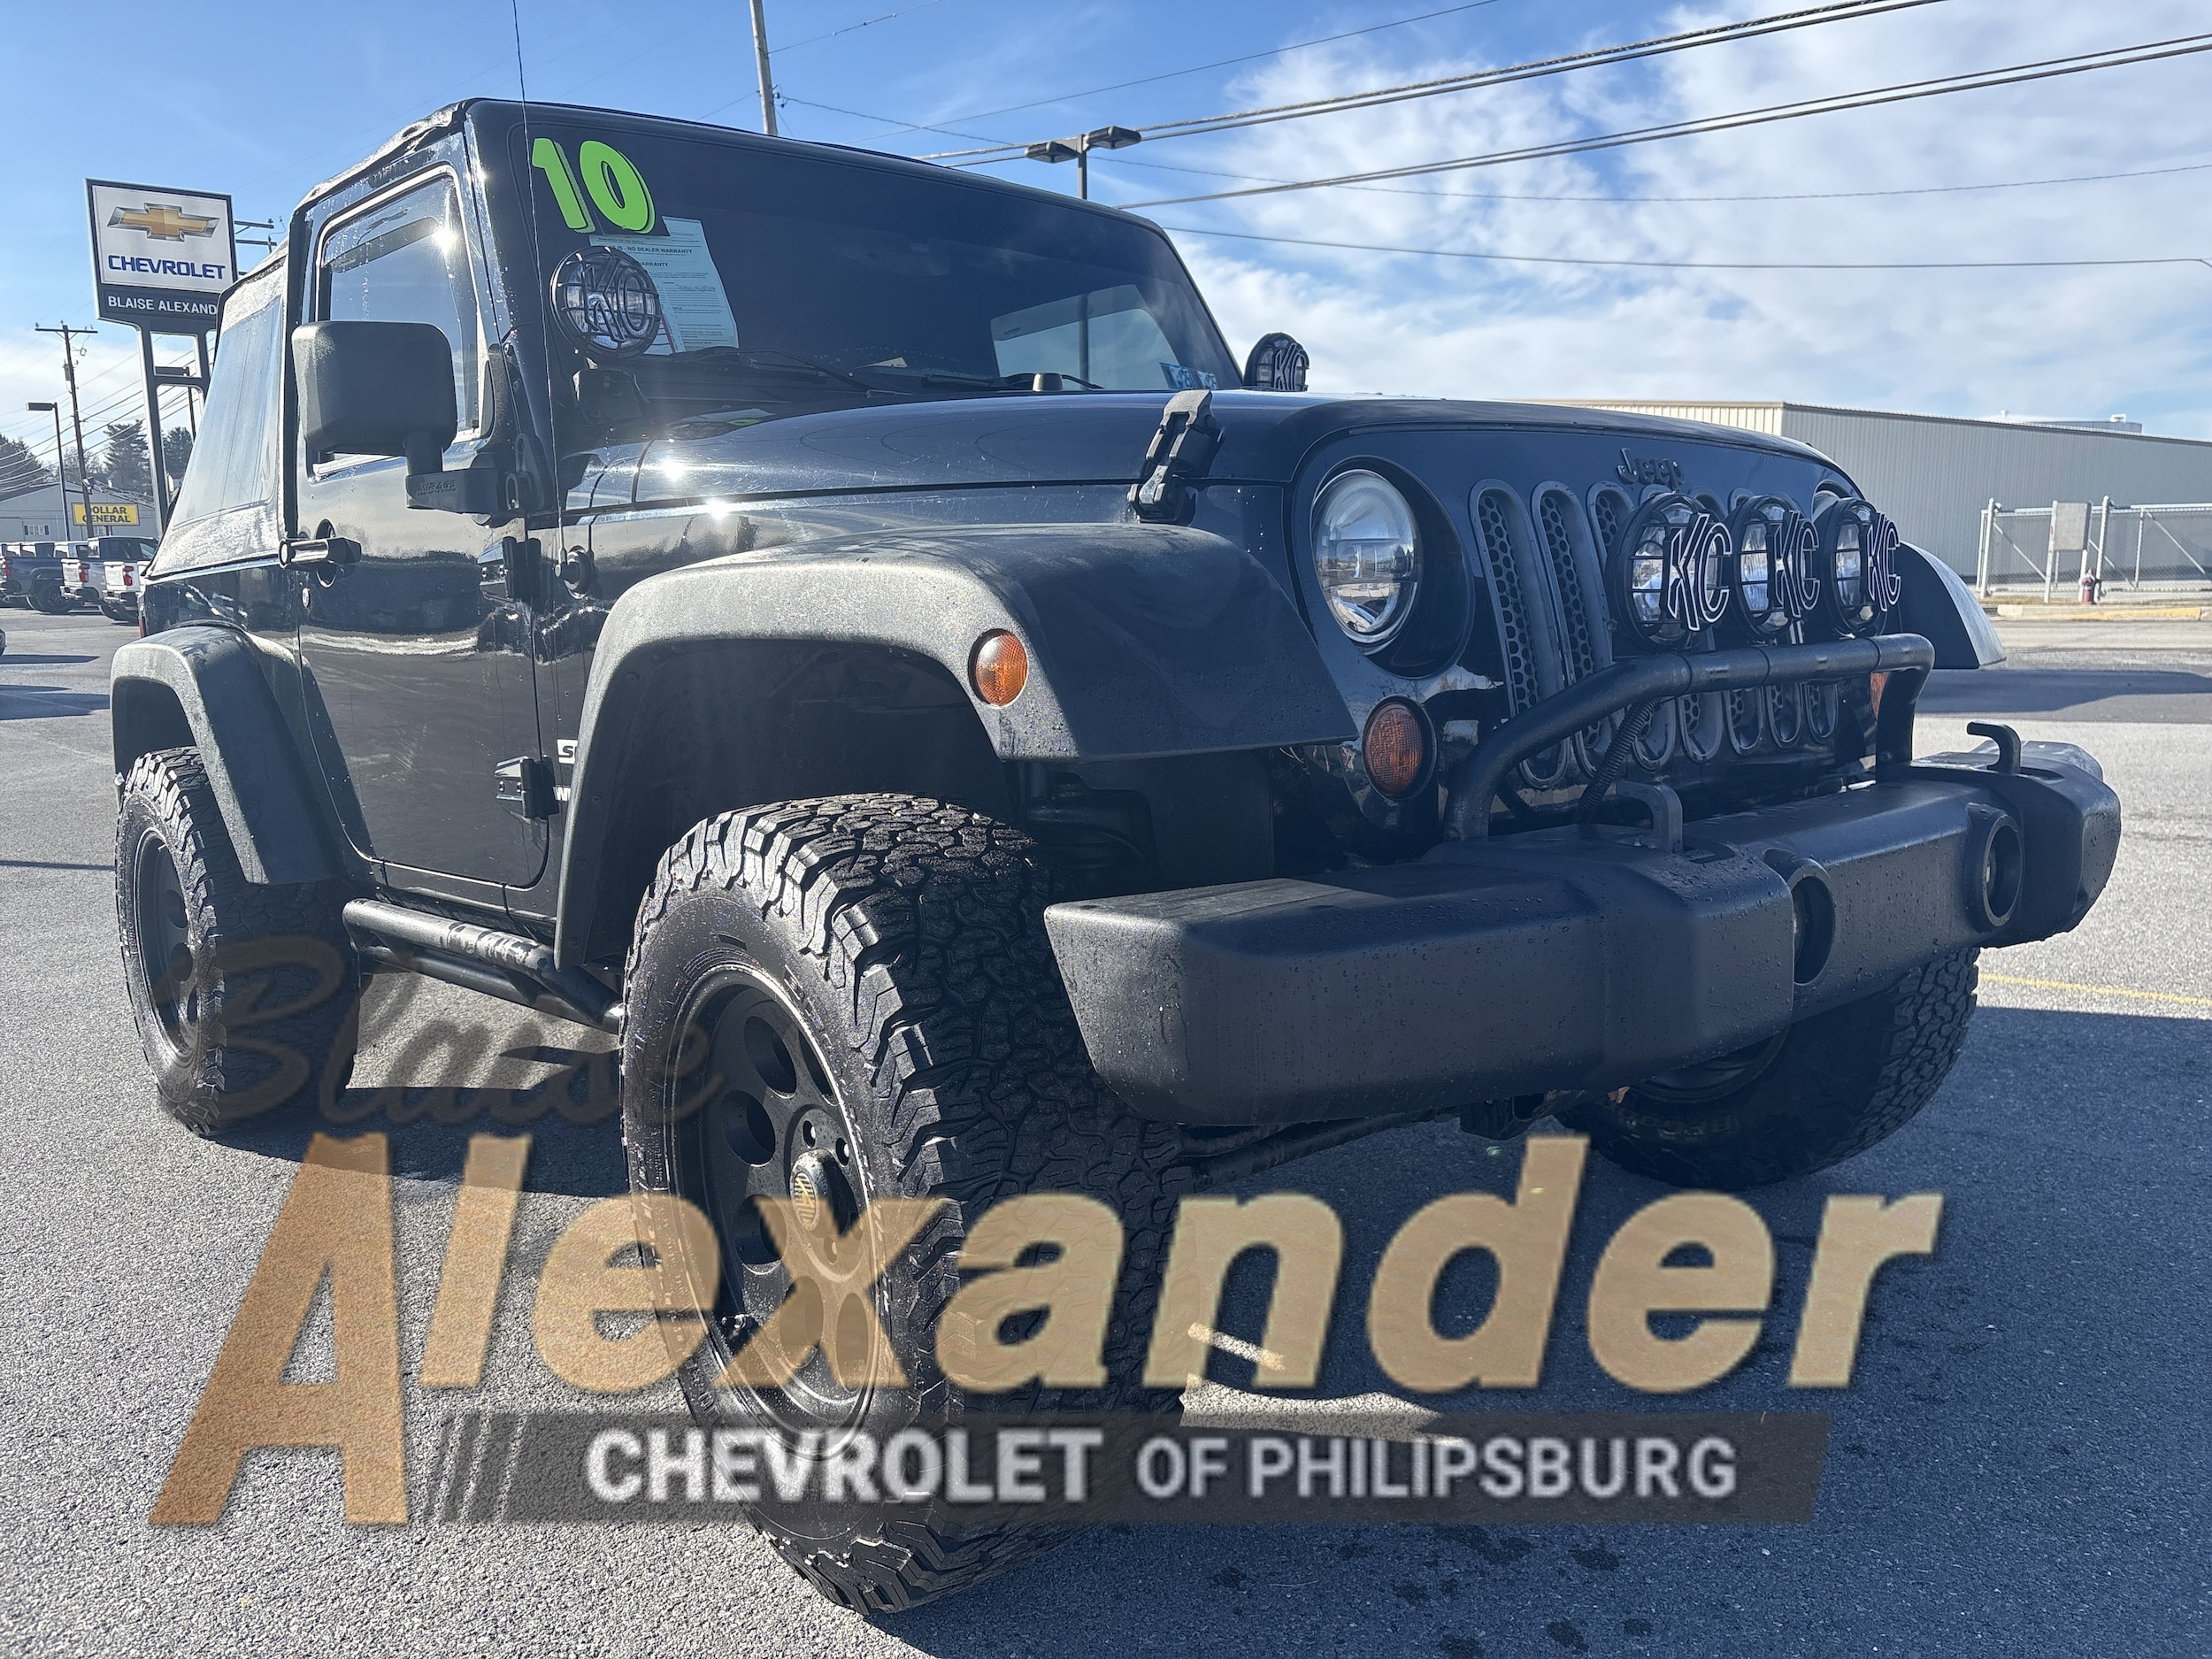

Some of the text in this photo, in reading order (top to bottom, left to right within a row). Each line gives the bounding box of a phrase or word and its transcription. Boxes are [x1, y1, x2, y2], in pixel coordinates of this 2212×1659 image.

[532, 138, 655, 234] 10
[108, 255, 226, 280] CHEVROLET
[108, 296, 155, 311] BLAISE
[1273, 342, 1307, 390] KC
[1615, 448, 1685, 491] Jeep
[1664, 512, 1732, 632] KC
[1773, 510, 1821, 618] KC
[1867, 511, 1901, 612] KC
